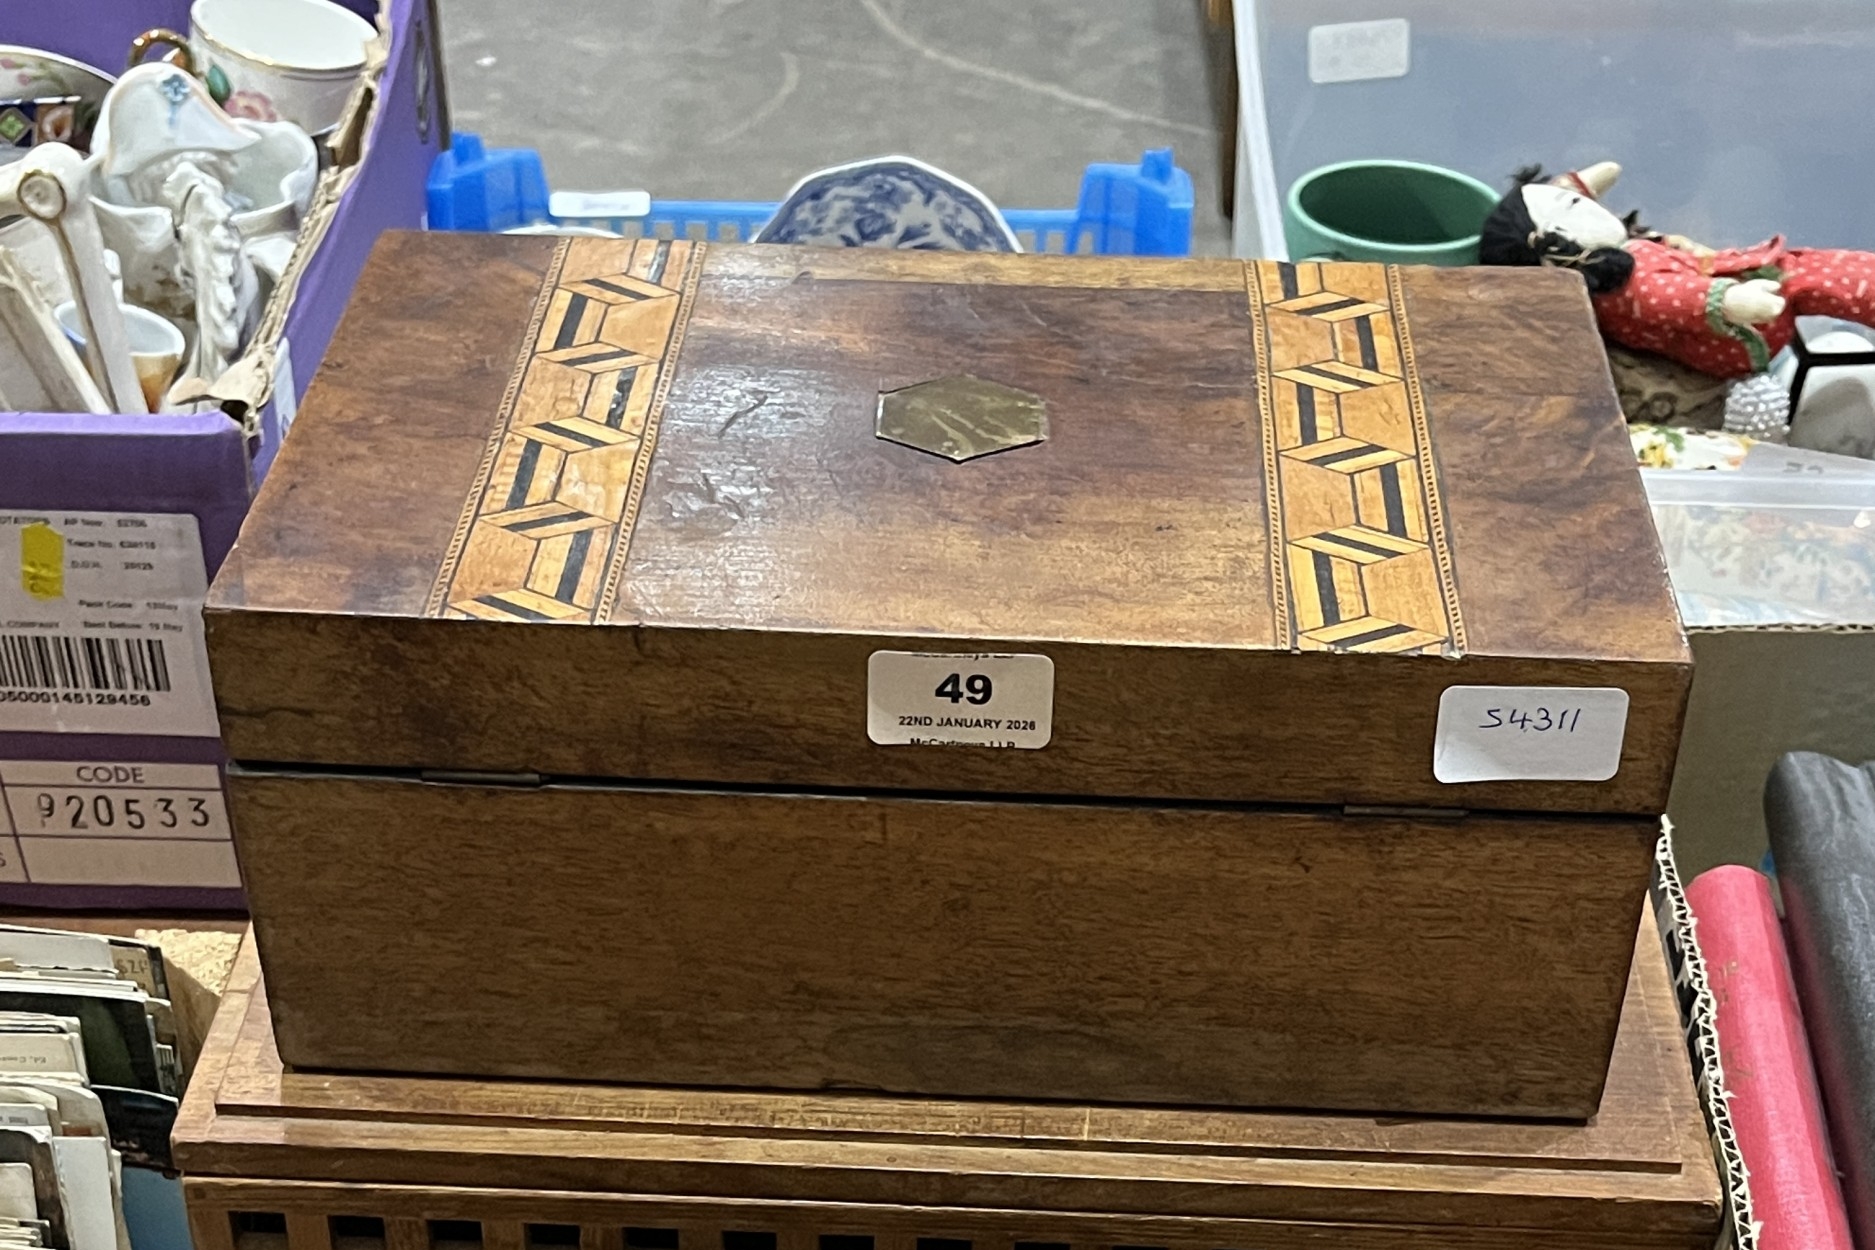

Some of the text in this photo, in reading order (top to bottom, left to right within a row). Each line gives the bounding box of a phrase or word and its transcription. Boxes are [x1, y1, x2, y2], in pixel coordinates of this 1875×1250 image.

[935, 673, 992, 705] 49
[898, 715, 1036, 731] 22ND JANUARY 2026
[77, 765, 145, 784] CODE
[37, 793, 210, 830] 920533
